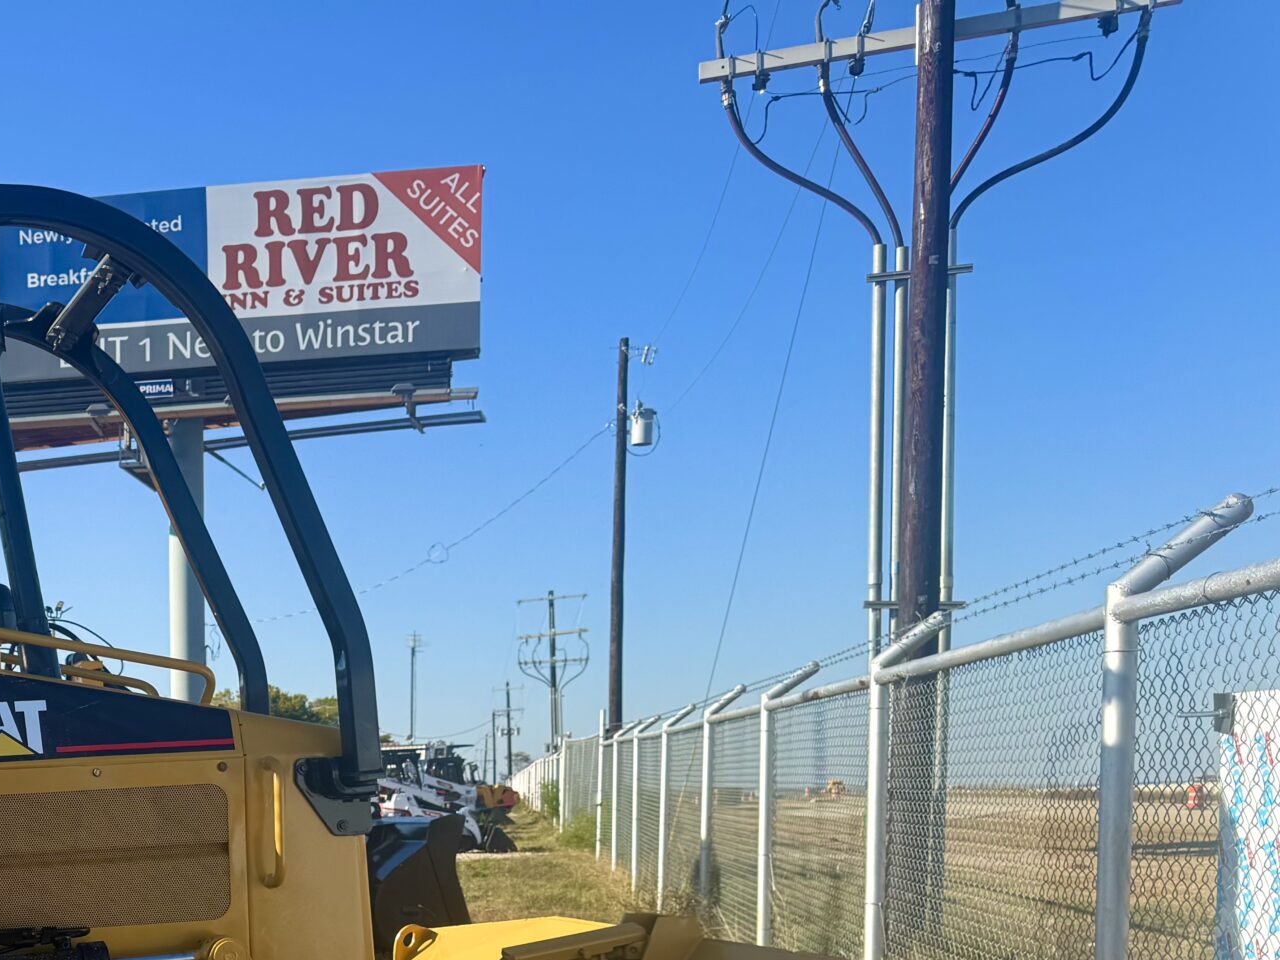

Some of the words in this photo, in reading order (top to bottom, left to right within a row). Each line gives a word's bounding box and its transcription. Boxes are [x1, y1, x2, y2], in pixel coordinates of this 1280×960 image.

[253, 183, 379, 237] RED
[406, 179, 479, 248] SUITES
[440, 172, 480, 214] ALL
[27, 268, 92, 288] Breakf
[222, 231, 414, 290] RIVER
[223, 291, 269, 310] NN
[283, 289, 305, 307] &
[318, 280, 419, 304] SUITES
[138, 337, 150, 362] 1
[167, 331, 211, 361] Ne
[252, 328, 284, 354] to
[295, 319, 420, 350] Winstar
